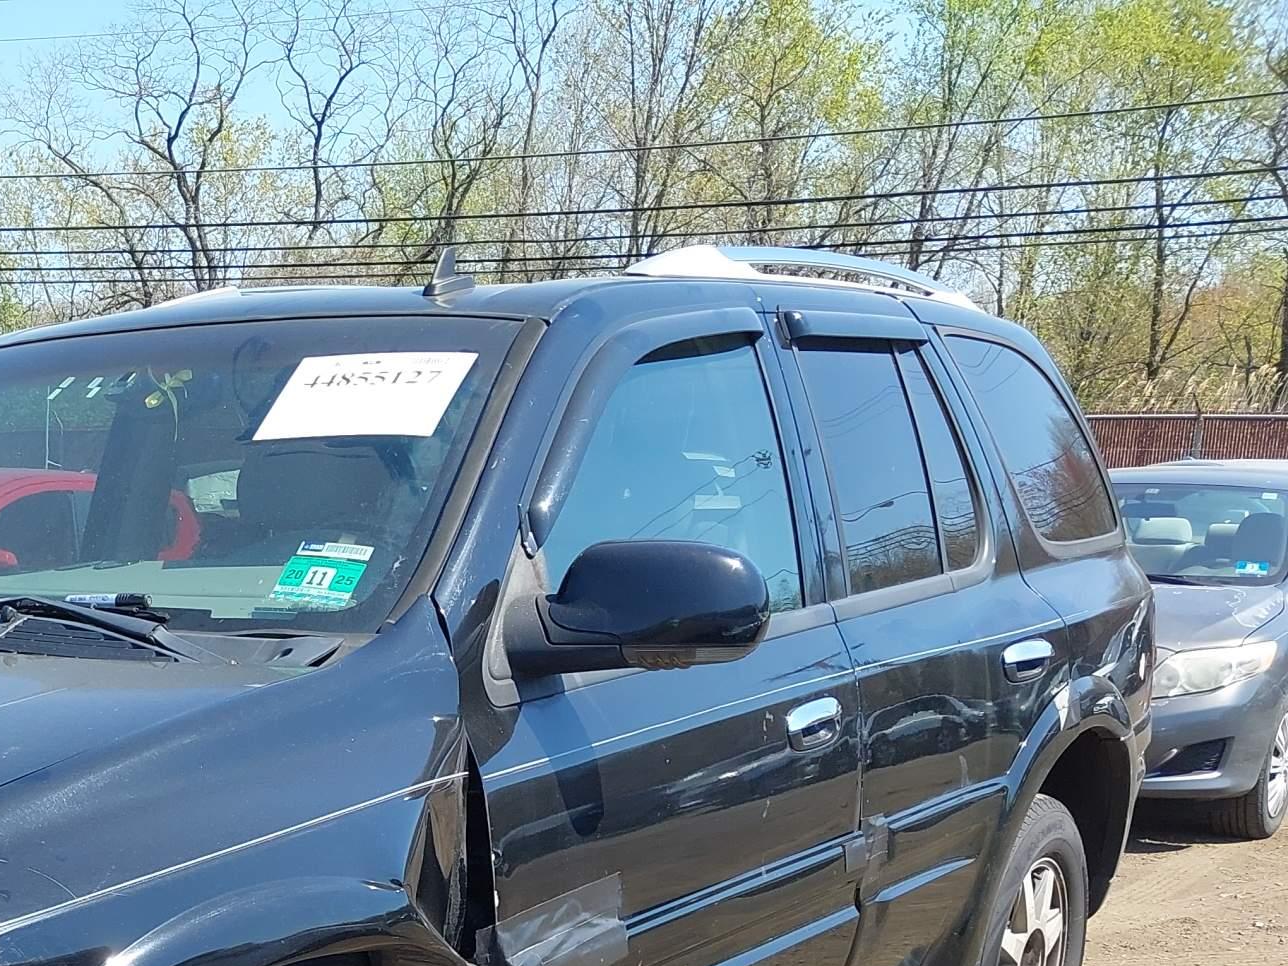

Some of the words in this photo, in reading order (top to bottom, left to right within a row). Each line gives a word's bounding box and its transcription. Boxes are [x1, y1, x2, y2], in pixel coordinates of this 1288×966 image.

[304, 369, 442, 389] 44855127
[285, 569, 304, 580] 20
[305, 569, 328, 586] 11
[335, 575, 356, 586] 25
